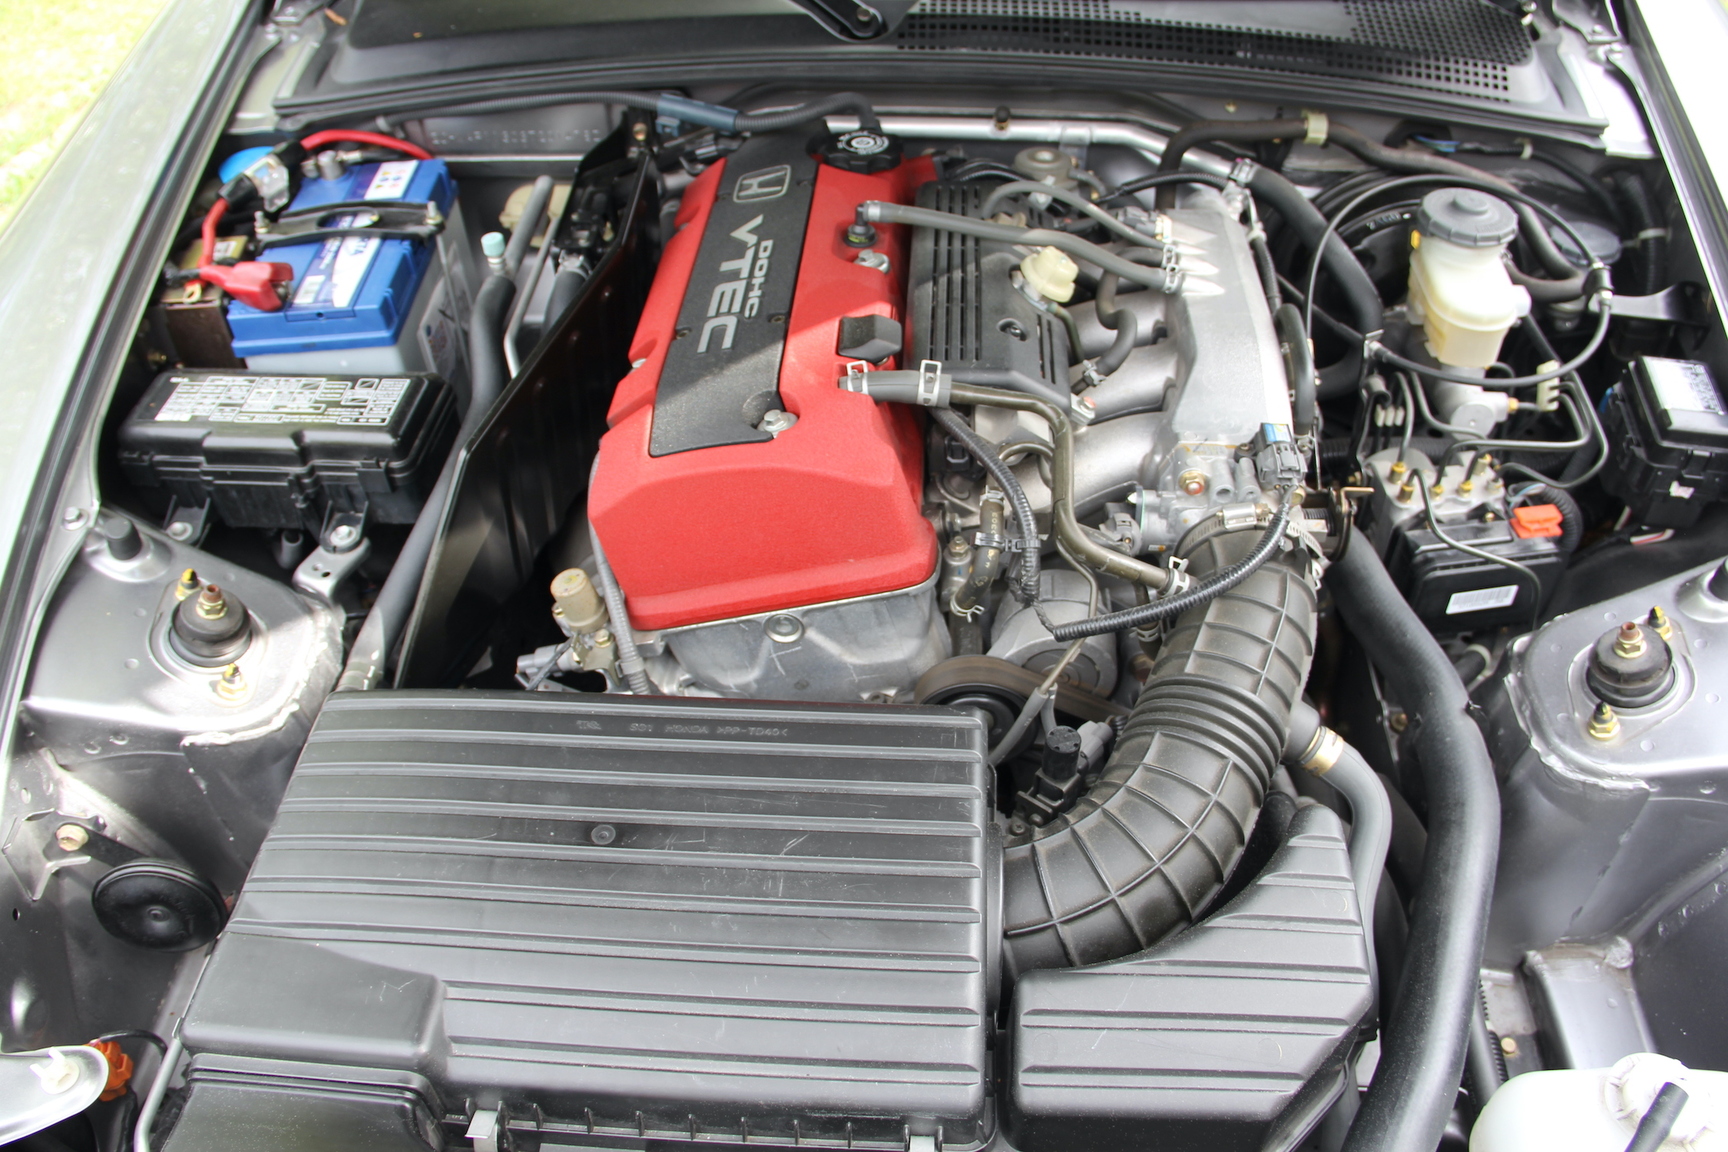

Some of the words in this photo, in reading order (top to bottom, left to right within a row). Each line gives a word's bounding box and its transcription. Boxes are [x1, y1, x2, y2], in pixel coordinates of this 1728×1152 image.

[697, 213, 764, 353] VTEC
[744, 239, 773, 318] DOHC
[664, 723, 709, 735] HONDA
